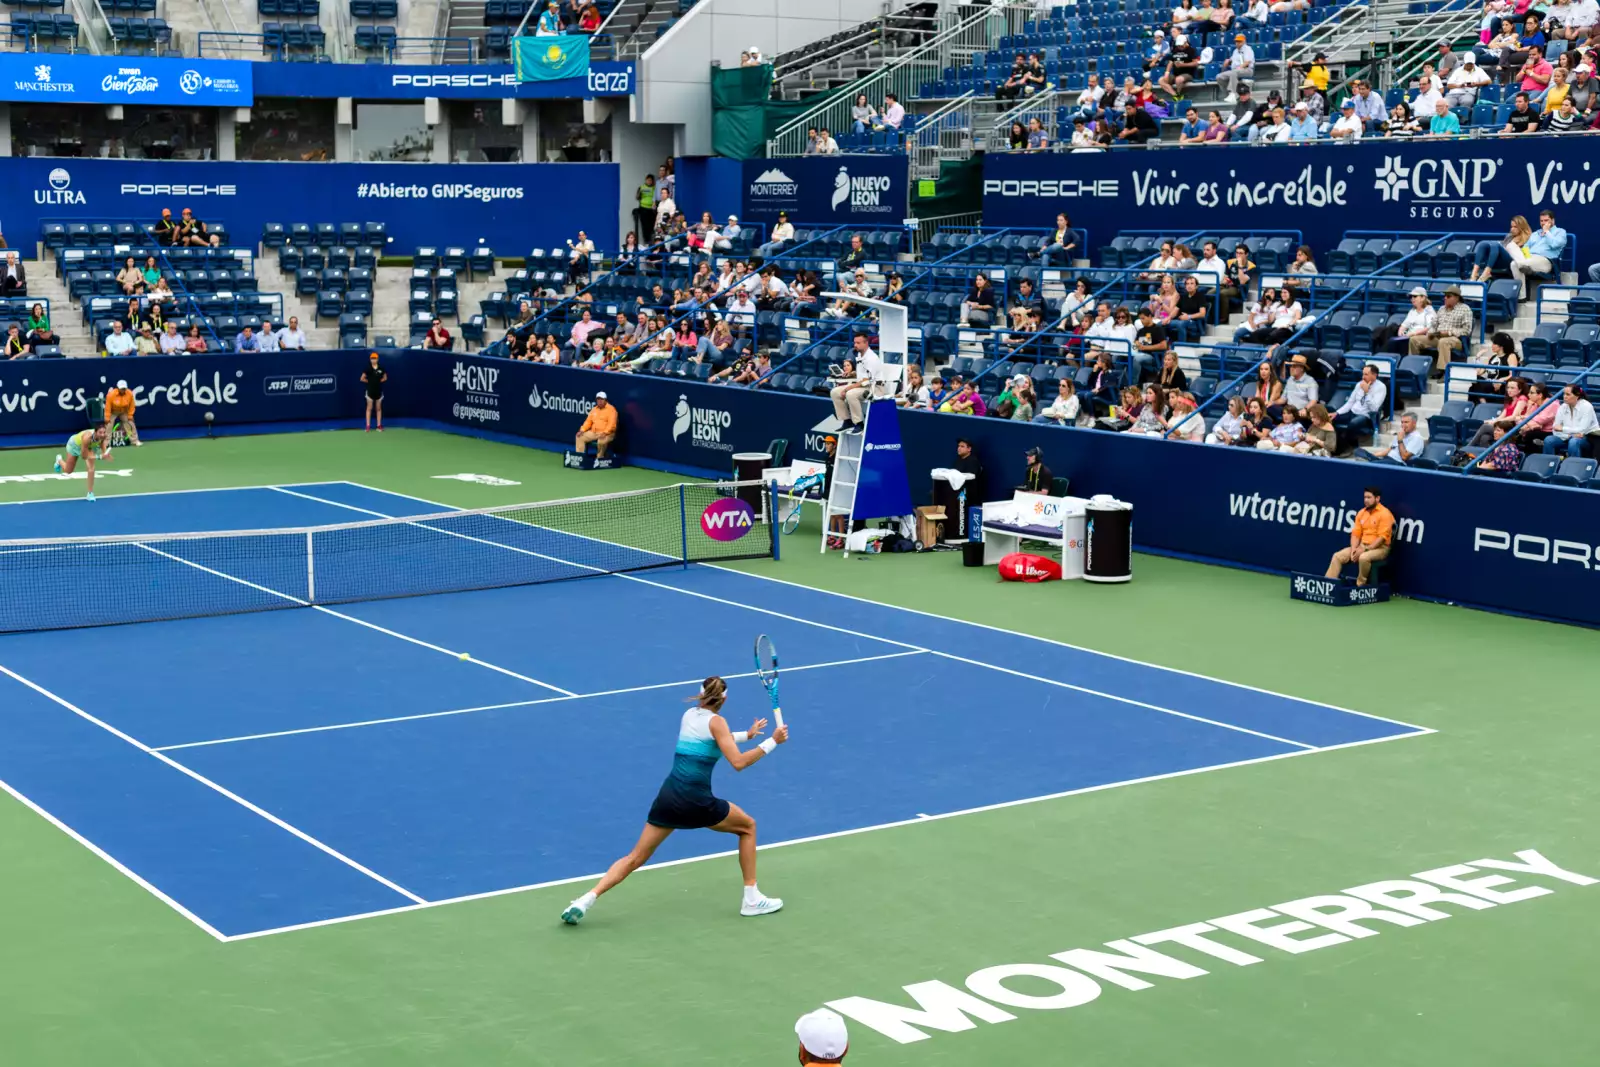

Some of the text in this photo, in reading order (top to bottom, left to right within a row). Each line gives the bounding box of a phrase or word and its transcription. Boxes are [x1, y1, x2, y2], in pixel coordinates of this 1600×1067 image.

[15, 81, 75, 92] MANCHESTER
[392, 74, 523, 87] PORSCHE
[588, 67, 628, 92] terza
[851, 175, 890, 191] NUEVO
[1132, 164, 1347, 208] Vivir es increíble
[1411, 158, 1497, 198] GNP
[1526, 159, 1600, 205] Vivir
[120, 184, 237, 196] PORSCHE
[357, 182, 524, 202] #Abierto GNPSeguros
[750, 183, 798, 196] MONTERREY
[984, 179, 1119, 197] PORSCHE
[34, 190, 86, 205] ULTRA
[1409, 206, 1496, 218] SEGUROS
[268, 381, 288, 390] ATP
[294, 377, 333, 385] CHALLENGER
[466, 365, 498, 393] GNP
[0, 379, 48, 413] vir
[58, 388, 87, 412] es
[466, 395, 499, 406] SEGUROS
[452, 402, 500, 422] @gnpseguros
[692, 407, 731, 429] NUEVO
[703, 510, 752, 529] WTA
[1306, 579, 1334, 596] GNP
[1358, 588, 1377, 599] GNP
[823, 848, 1600, 1044] MONTERREY
